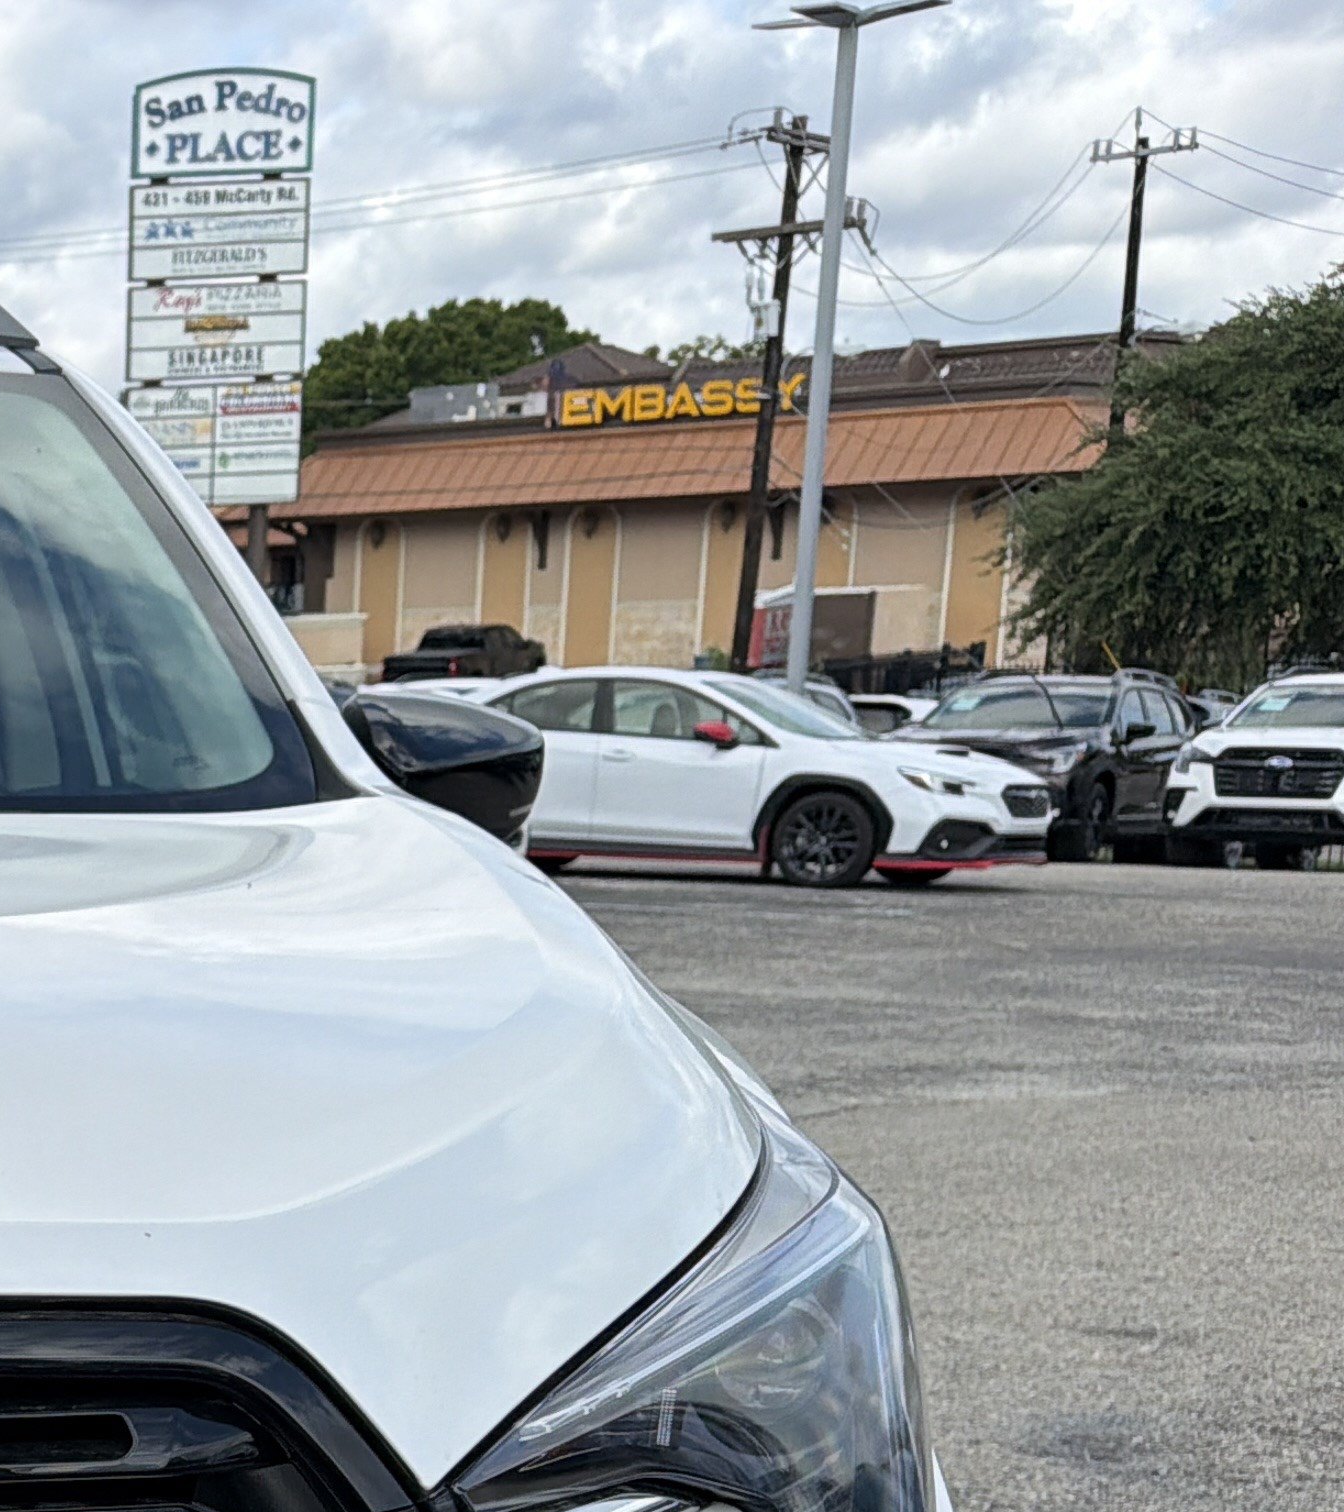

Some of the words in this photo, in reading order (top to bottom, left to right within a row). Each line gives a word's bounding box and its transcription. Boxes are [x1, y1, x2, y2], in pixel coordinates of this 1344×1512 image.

[145, 92, 207, 128] San
[214, 80, 306, 123] Pedro
[165, 130, 283, 164] PLACE
[215, 187, 273, 206] McCarty
[562, 373, 806, 426] EMBASSY
